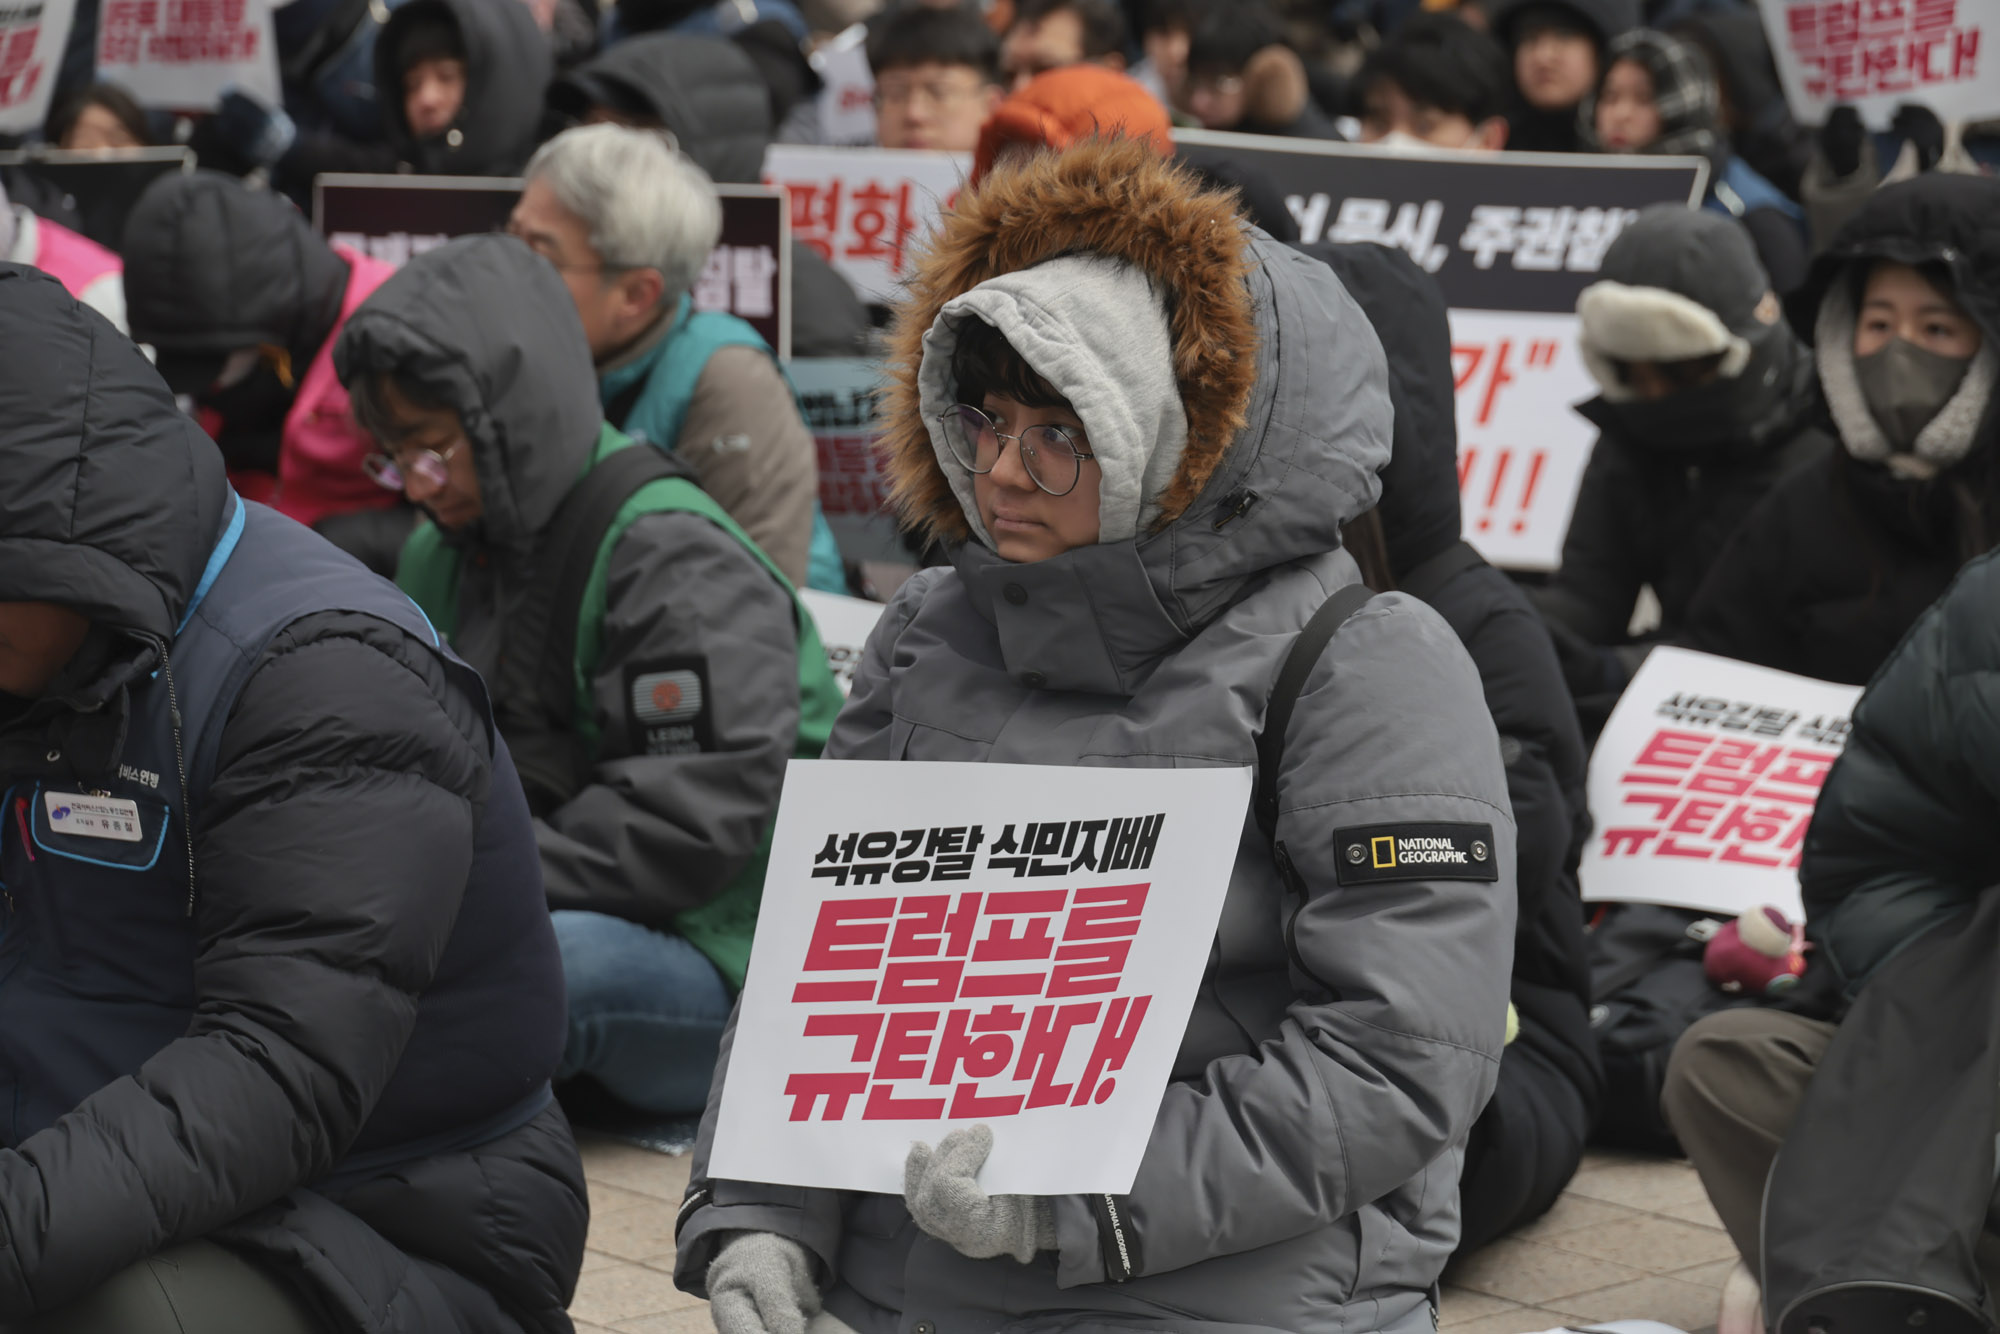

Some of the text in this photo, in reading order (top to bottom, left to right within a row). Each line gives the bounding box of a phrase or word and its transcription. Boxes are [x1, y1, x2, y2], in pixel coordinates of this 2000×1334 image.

[1620, 729, 1839, 806] 트럼프
[810, 812, 1167, 887] 석유강탈 식민지배
[1398, 837, 1455, 851] NATIONAL
[1398, 851, 1469, 864] GEOGRAPHIC
[1602, 793, 1812, 869] 규탄한
[790, 881, 1152, 1006] 트럼프를
[783, 994, 1154, 1122] 규탄한다!
